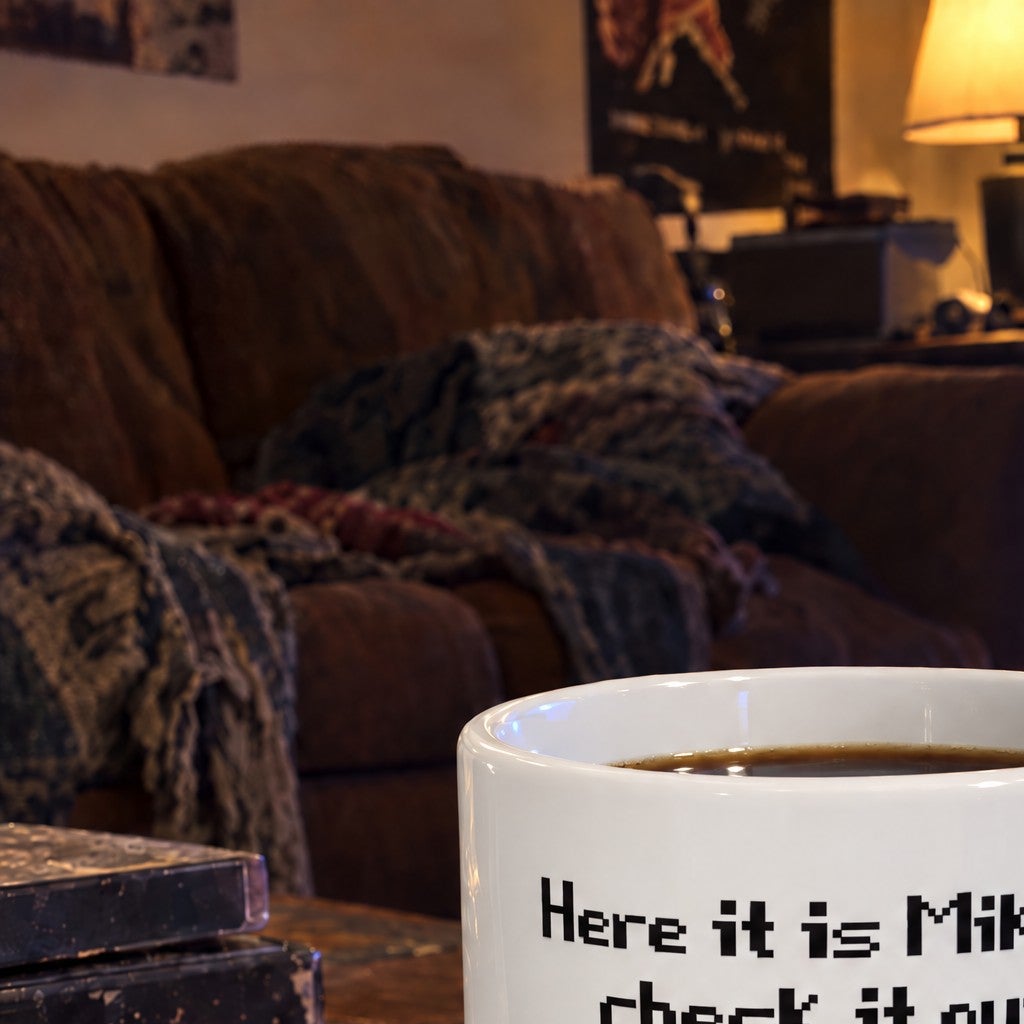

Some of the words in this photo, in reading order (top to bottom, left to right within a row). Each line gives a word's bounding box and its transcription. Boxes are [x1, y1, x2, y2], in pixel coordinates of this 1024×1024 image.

[541, 876, 687, 955] Here
[711, 899, 775, 959] it
[801, 901, 880, 959] is
